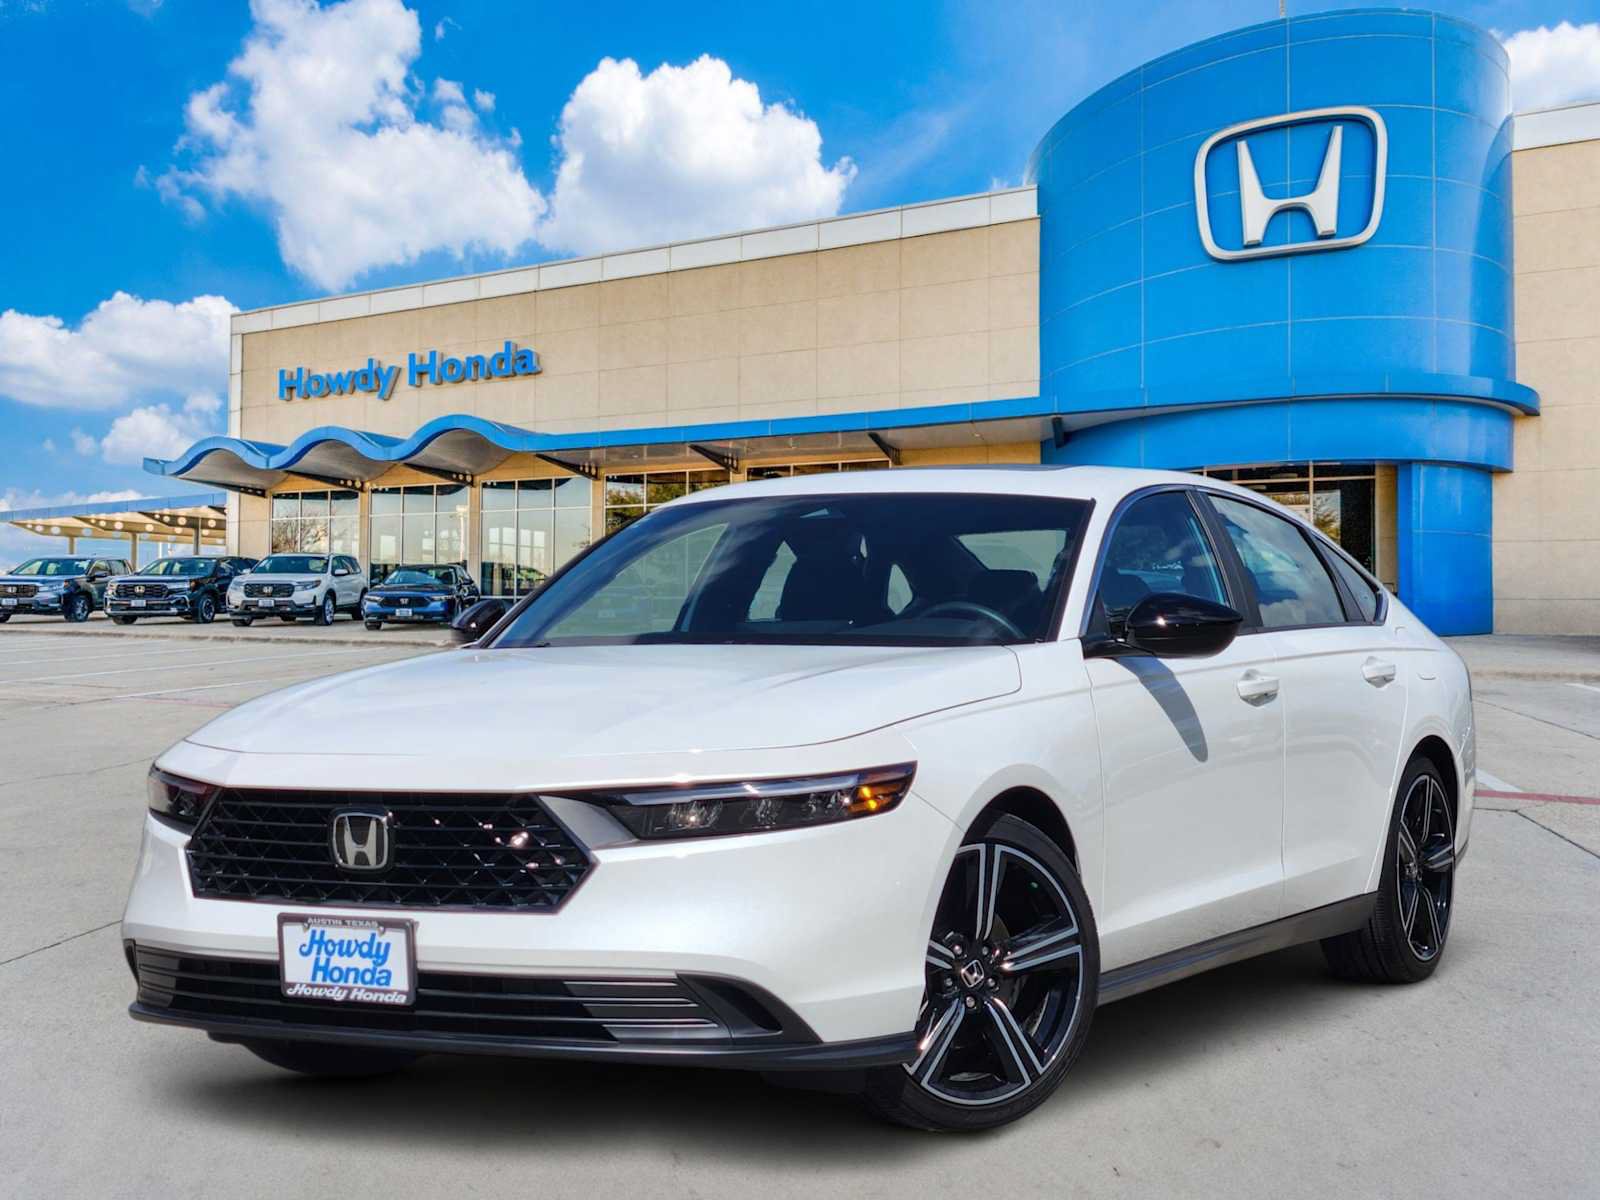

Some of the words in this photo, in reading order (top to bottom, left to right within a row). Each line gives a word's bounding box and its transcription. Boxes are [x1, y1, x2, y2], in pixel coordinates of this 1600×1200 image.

[278, 357, 401, 400] Howdy
[407, 340, 542, 388] Honda
[307, 917, 342, 926] AUSTIN
[345, 919, 378, 927] TEXAS
[299, 929, 391, 967] Howdy
[311, 957, 392, 986] Honda
[287, 983, 348, 1001] Howdy
[350, 988, 407, 1003] Honda
